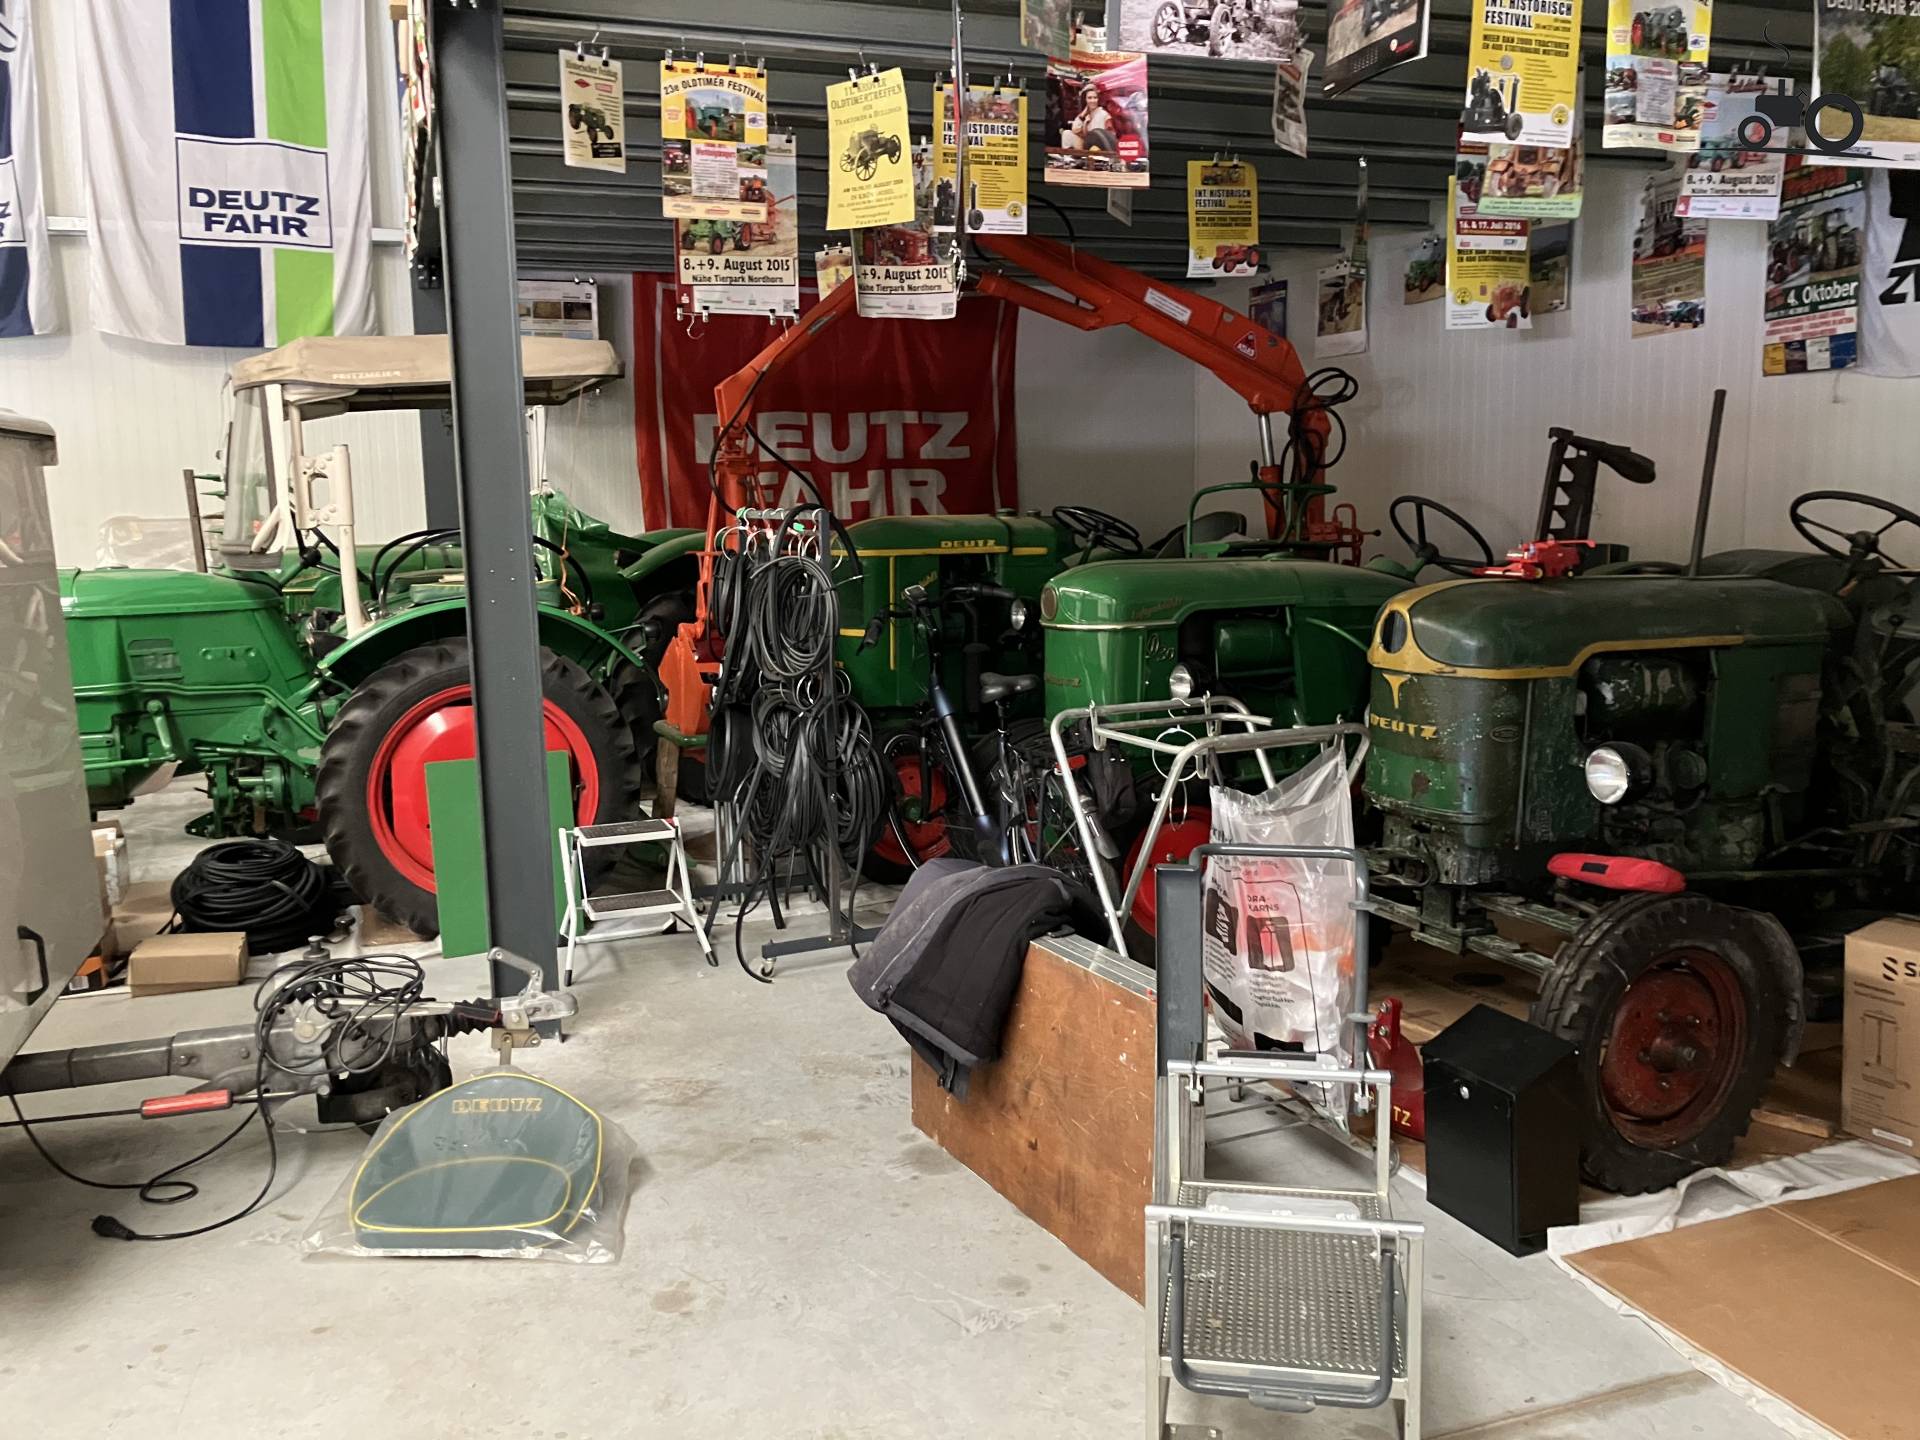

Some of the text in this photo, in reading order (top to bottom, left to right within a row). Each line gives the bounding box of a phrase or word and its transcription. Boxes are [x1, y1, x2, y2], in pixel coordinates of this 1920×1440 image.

[1484, 10, 1533, 28] FESTIVAL
[663, 78, 765, 103] 23e OLDTIMER FESTIVAL
[968, 123, 1018, 136] ISTORISCH
[1719, 174, 1753, 187] August
[188, 186, 320, 217] DEUTZ
[1195, 199, 1227, 208] FESTIVAL
[203, 211, 309, 238] FAHR
[723, 257, 763, 274] August
[766, 258, 790, 271] 2015
[714, 274, 746, 284] Tierpark
[748, 274, 784, 283] Nordhorn
[884, 268, 921, 284] August
[924, 267, 948, 280] 2015
[876, 283, 905, 294] Tierpark
[907, 284, 942, 292] Nordhorn
[1802, 280, 1859, 304] Oktober
[940, 539, 996, 548] DEUTZ
[1370, 713, 1439, 742] DEUTZ
[451, 1097, 543, 1115] DEUTZ
